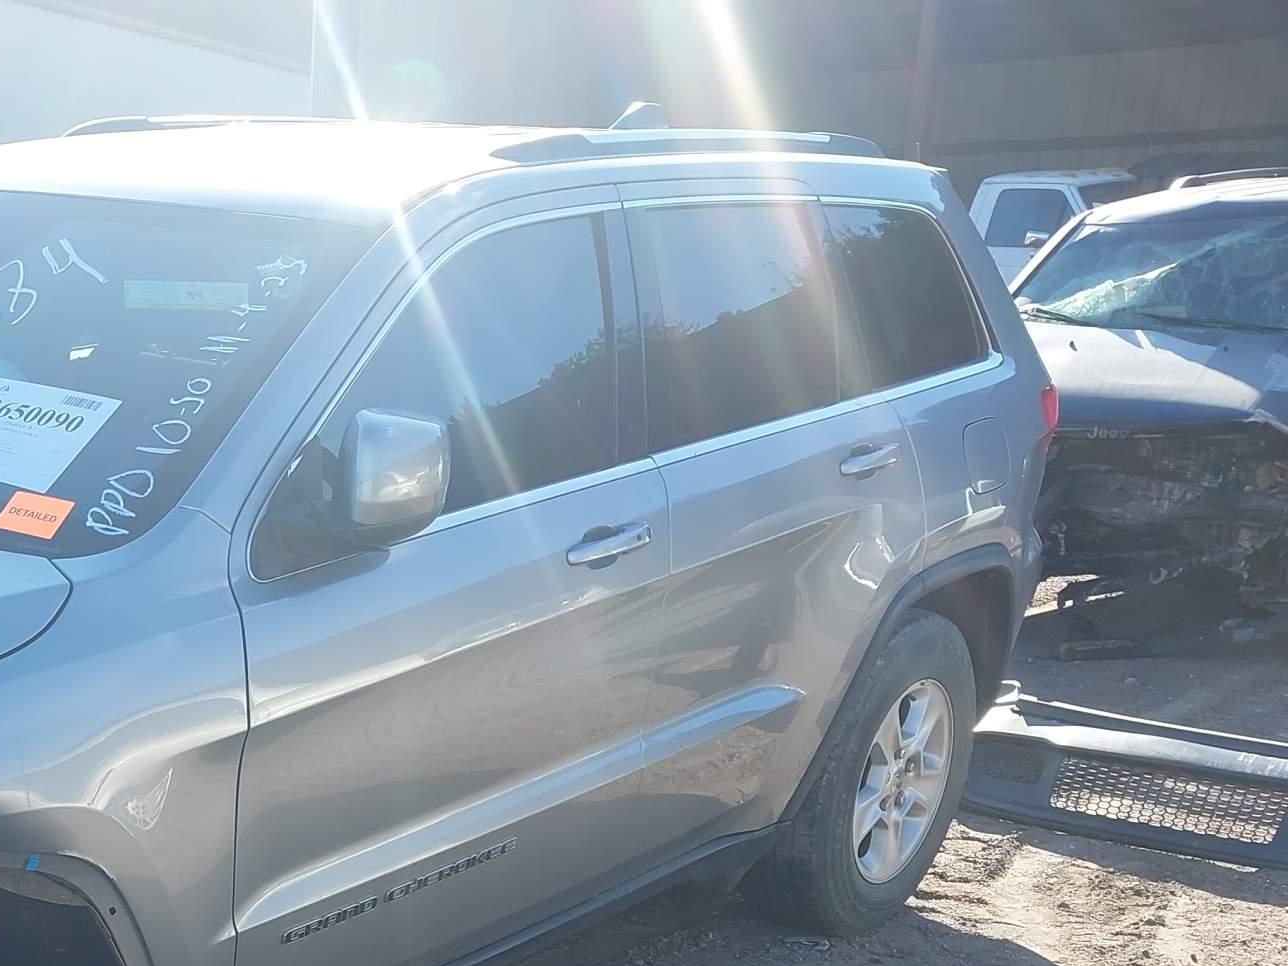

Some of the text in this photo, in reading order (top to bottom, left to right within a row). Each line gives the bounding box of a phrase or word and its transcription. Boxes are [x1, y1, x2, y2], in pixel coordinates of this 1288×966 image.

[8, 506, 57, 523] DETAILED
[280, 836, 517, 944] GRAND CHEROKEE
